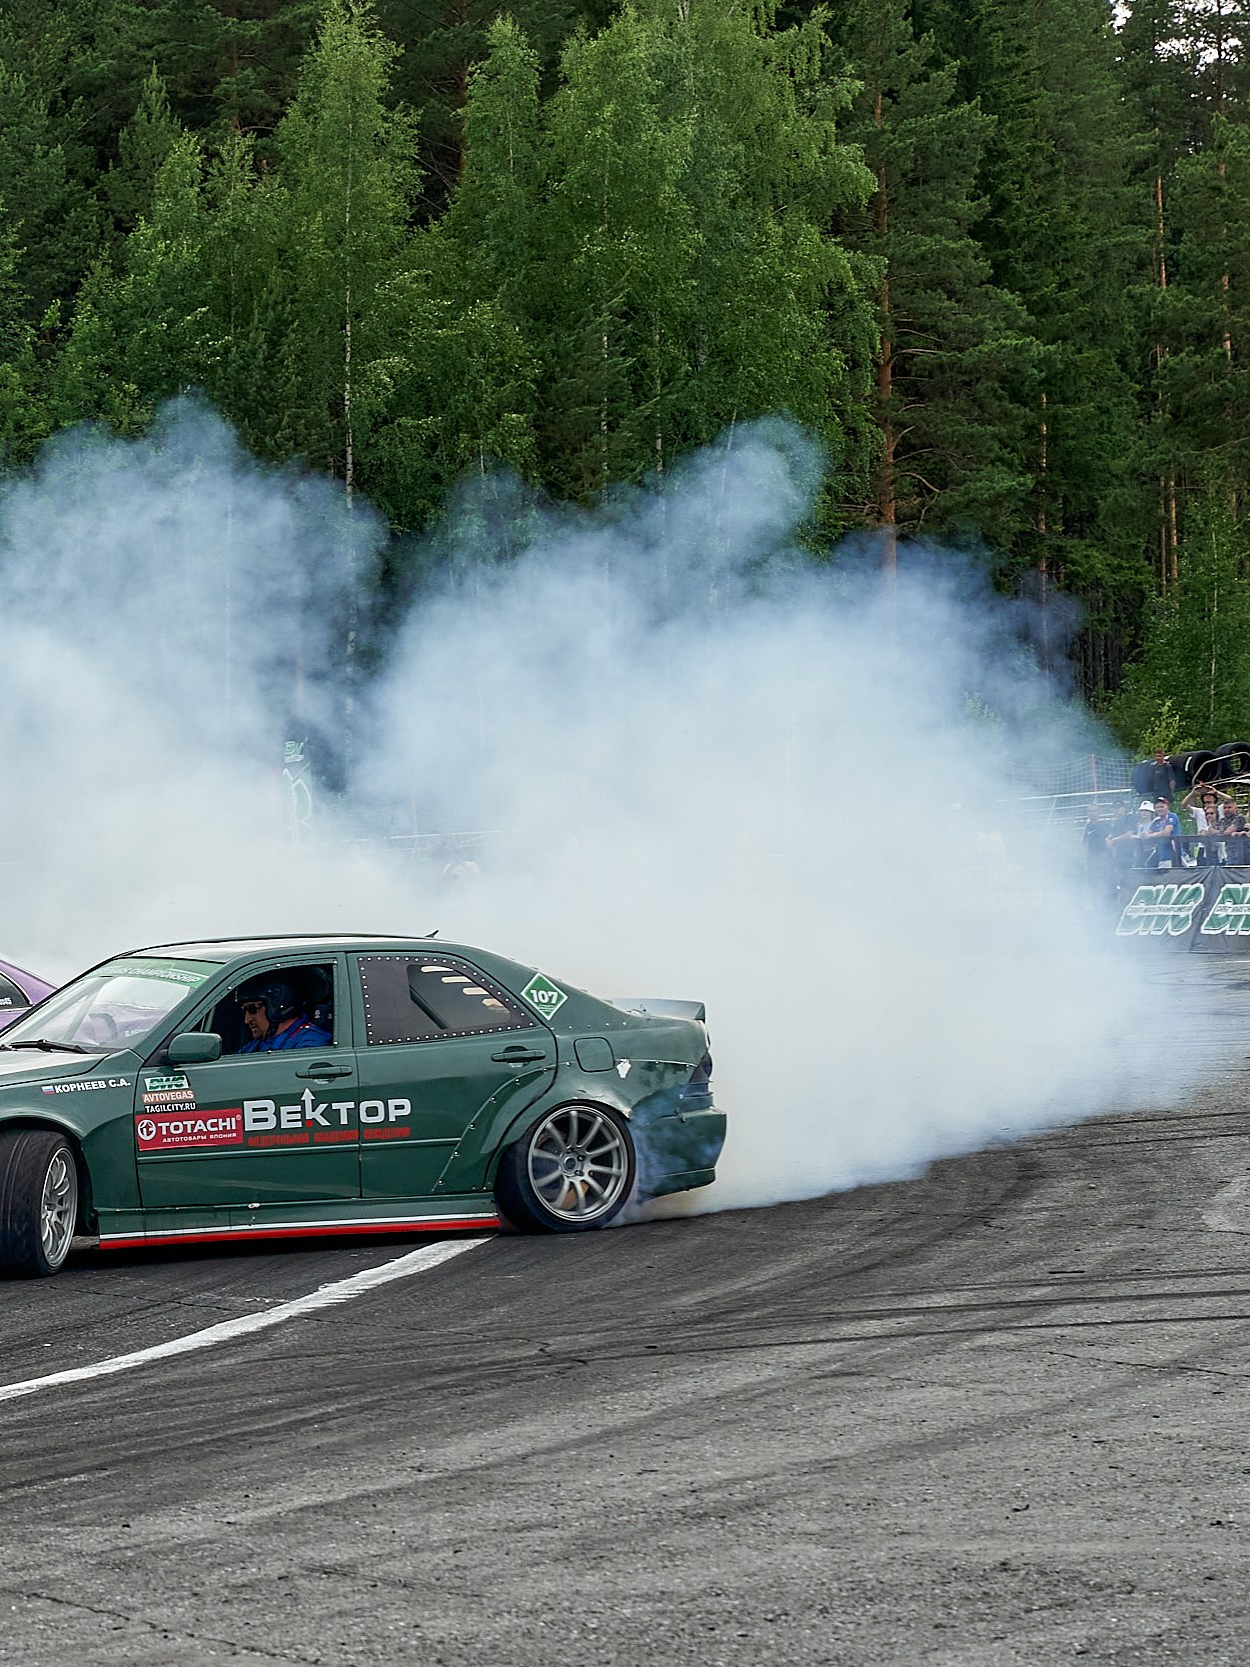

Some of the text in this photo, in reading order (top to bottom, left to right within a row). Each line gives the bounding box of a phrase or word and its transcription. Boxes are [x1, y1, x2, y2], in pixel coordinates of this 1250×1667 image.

[530, 990, 558, 1004] 107
[54, 1078, 132, 1094] КОРНЕЕВ С.А.
[149, 1076, 185, 1090] DWC
[143, 1090, 194, 1103] AVTOVEGAS
[144, 1102, 196, 1114] TAGILCITY.RU
[158, 1117, 237, 1136] TOTACHI
[162, 1135, 207, 1143] АВТОТОВАРЫ
